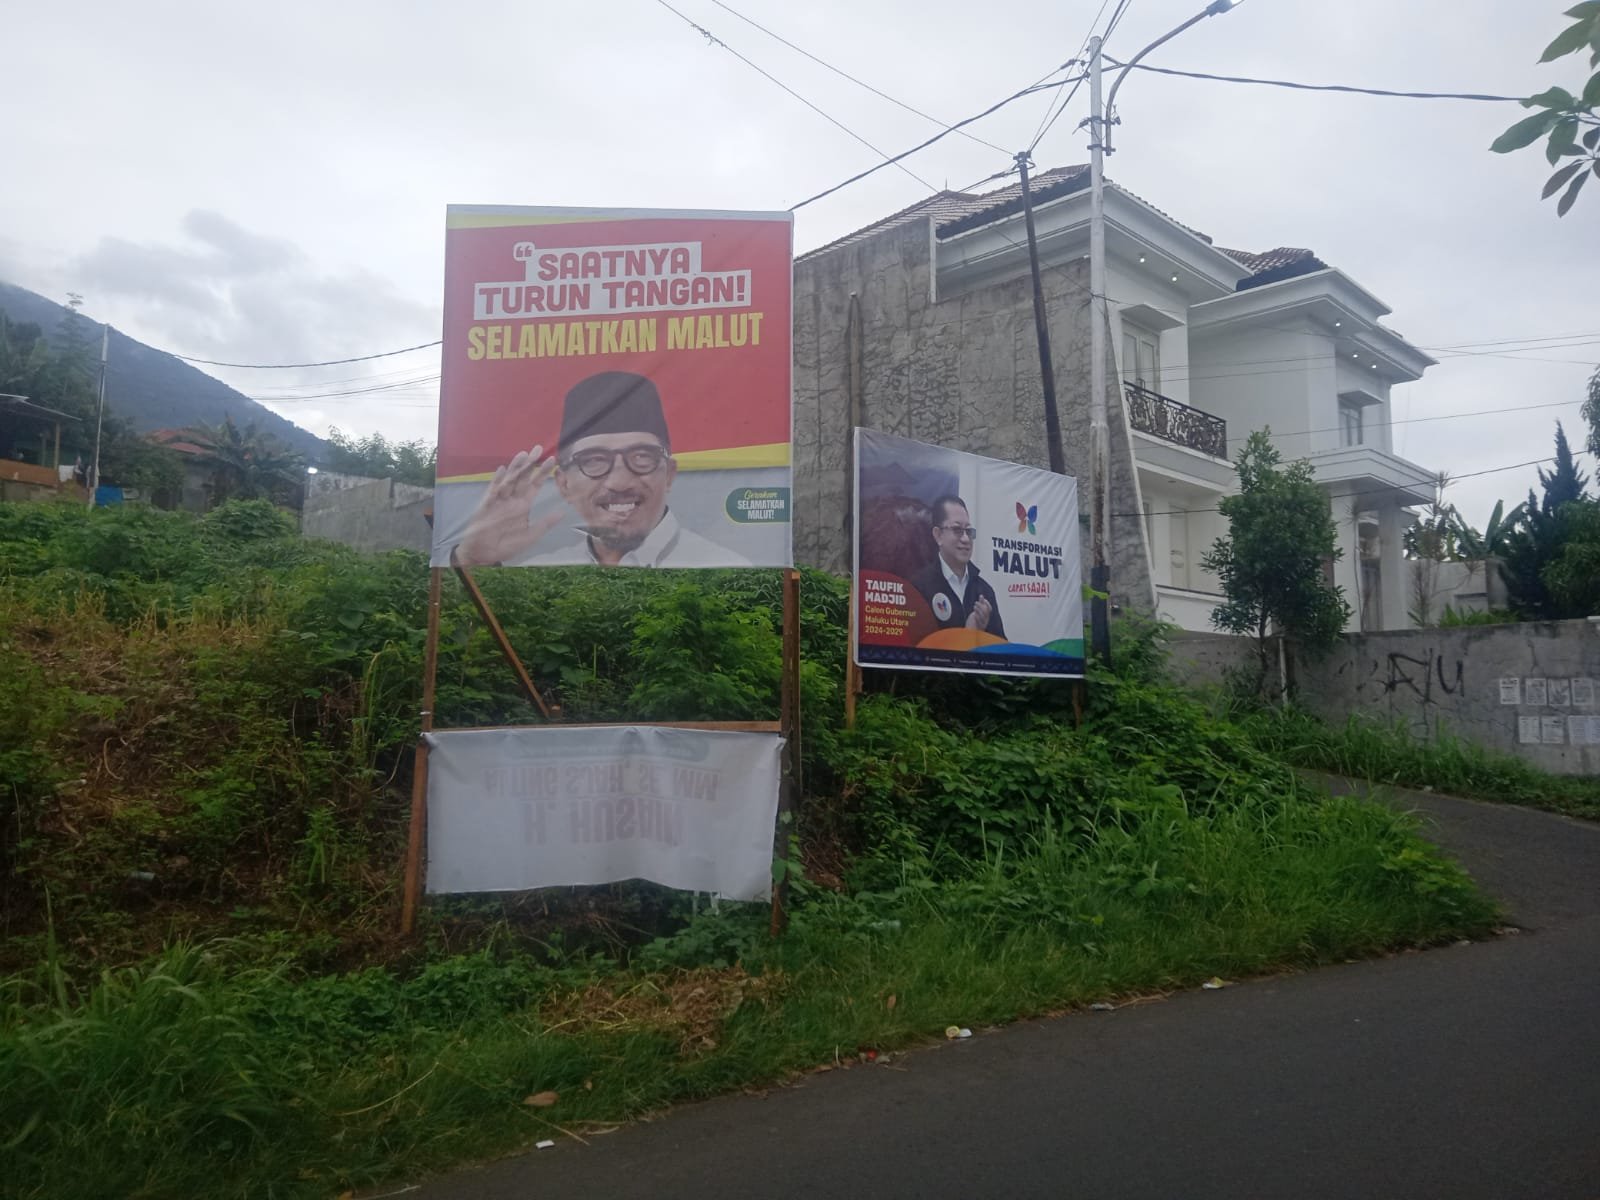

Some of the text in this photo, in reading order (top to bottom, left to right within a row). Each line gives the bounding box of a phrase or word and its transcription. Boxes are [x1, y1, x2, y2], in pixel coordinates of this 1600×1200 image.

[478, 275, 746, 315] TURUN TANGAN!
[467, 312, 764, 361] SELAMATKAN MALUT
[738, 500, 784, 509] SELAMATKAN
[748, 510, 774, 520] MALUT!
[992, 537, 1062, 557] TRANSFORMASI
[993, 550, 1062, 579] MALUT
[865, 580, 904, 593] TAUFIK
[865, 592, 906, 605] MADJID
[865, 616, 889, 625] Maluku
